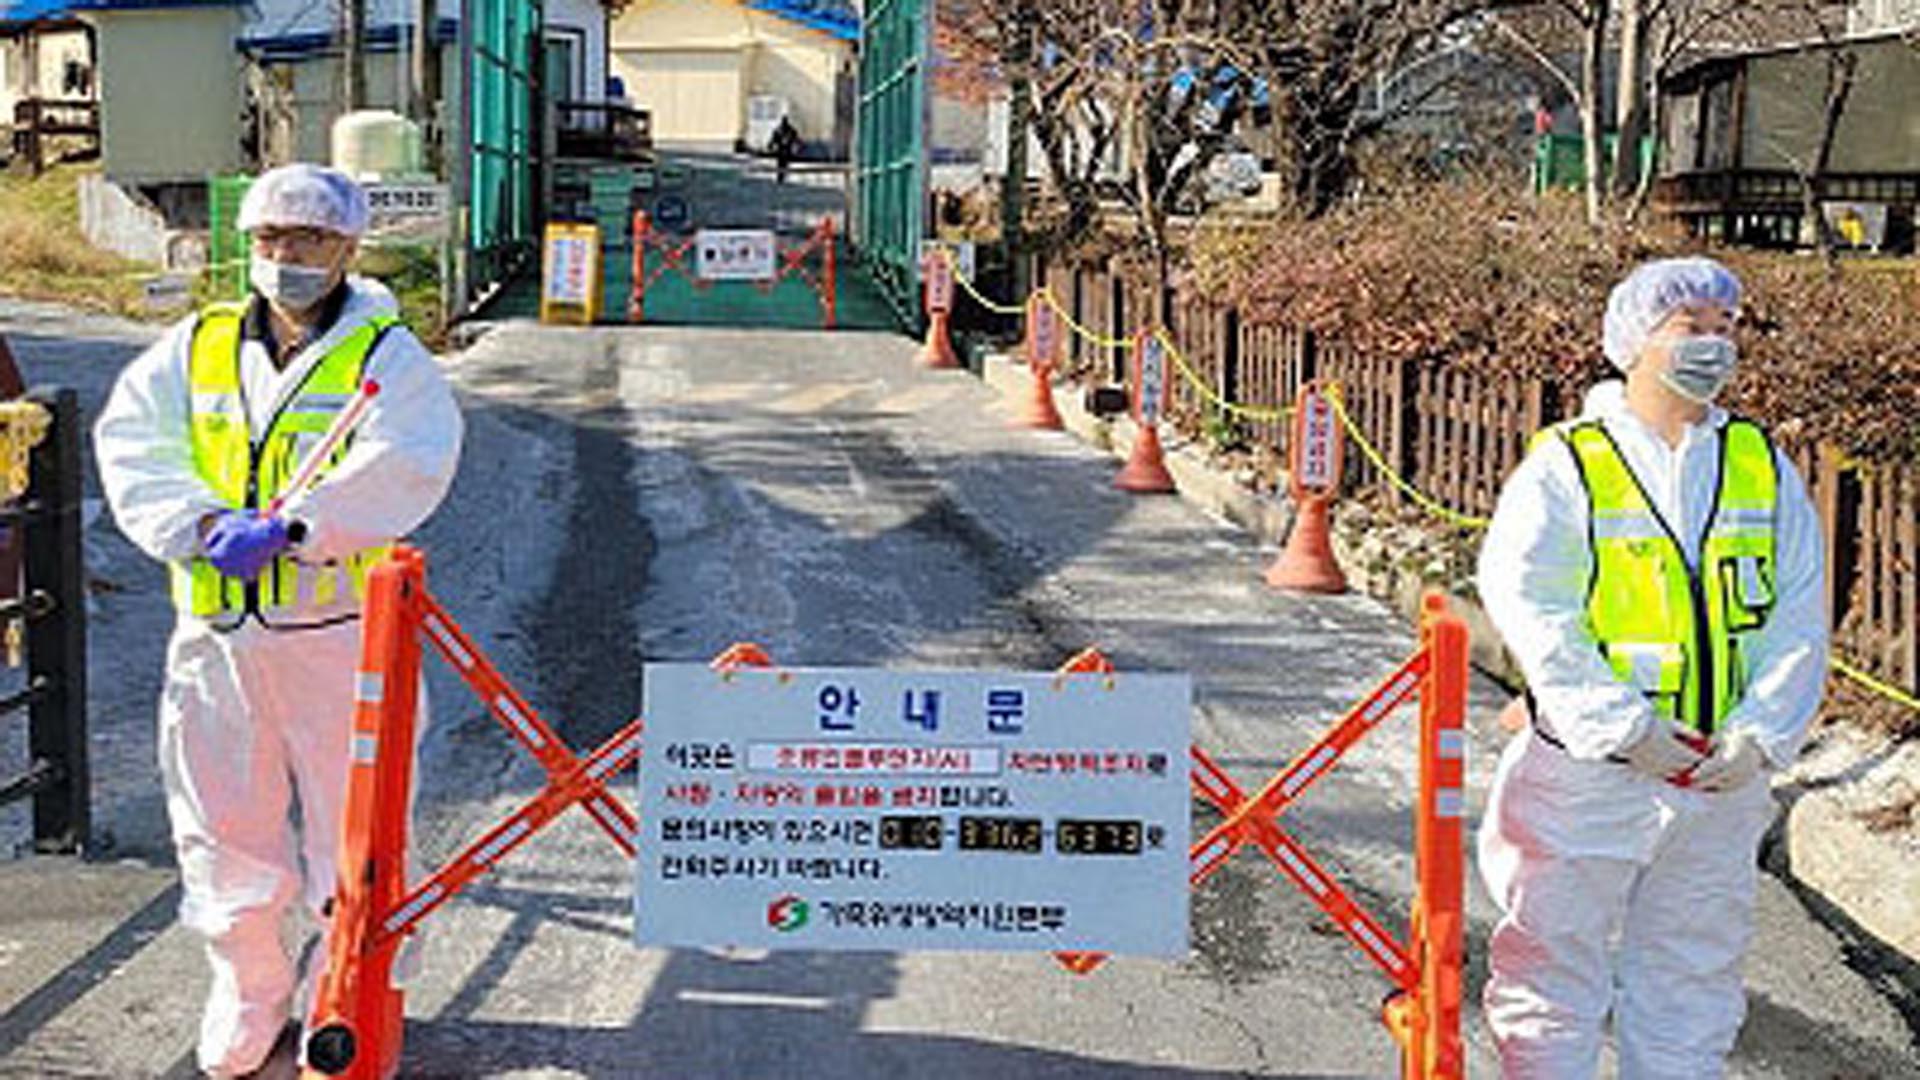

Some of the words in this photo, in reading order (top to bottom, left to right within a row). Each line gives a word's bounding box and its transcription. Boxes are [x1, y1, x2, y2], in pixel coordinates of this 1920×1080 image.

[665, 743, 736, 769] 이곳은
[661, 817, 776, 845] 문의사항이
[782, 817, 874, 845] 있으시면
[660, 856, 779, 880] 전화주시기
[784, 857, 890, 880] 바랍니다.
[819, 900, 1066, 933] 가축위생방역지원본부
